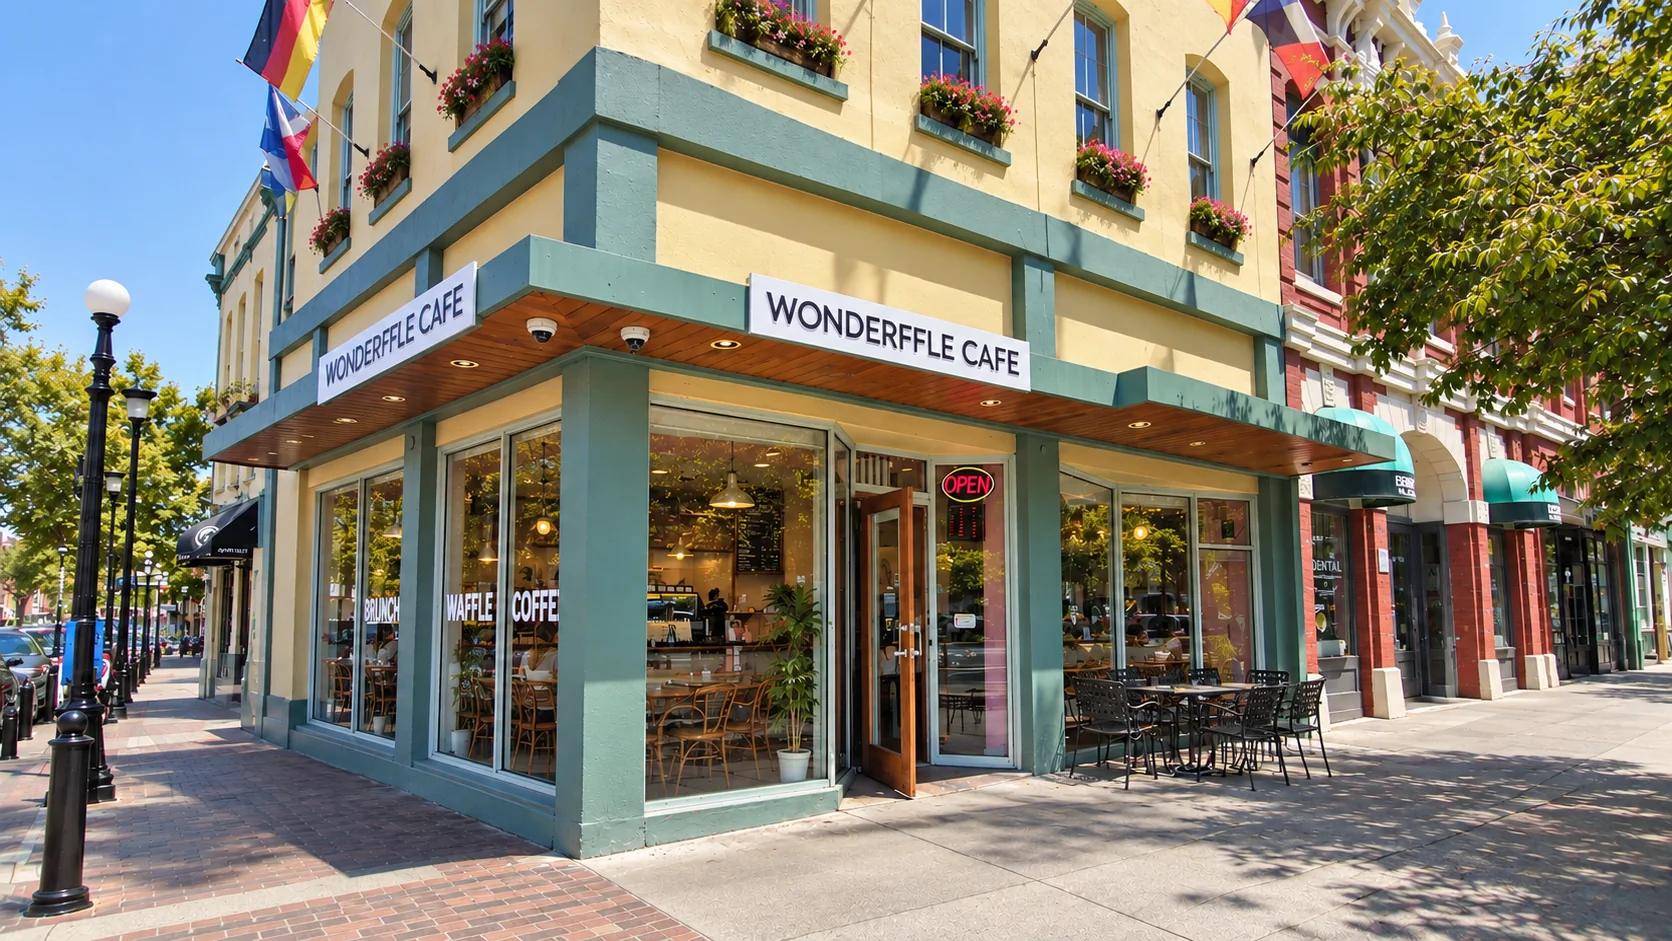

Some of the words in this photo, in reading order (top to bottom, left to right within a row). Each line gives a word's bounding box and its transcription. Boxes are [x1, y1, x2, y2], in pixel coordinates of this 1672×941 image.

[325, 312, 415, 387] WONDERFFLE
[418, 282, 464, 335] CAFE
[766, 291, 955, 361] WONDERFFLE
[961, 340, 1020, 376] CAFE
[944, 475, 991, 494] OPEN
[1312, 560, 1342, 572] DENTAL
[364, 596, 400, 622] BRUNCH
[446, 592, 493, 621] WAFFLE
